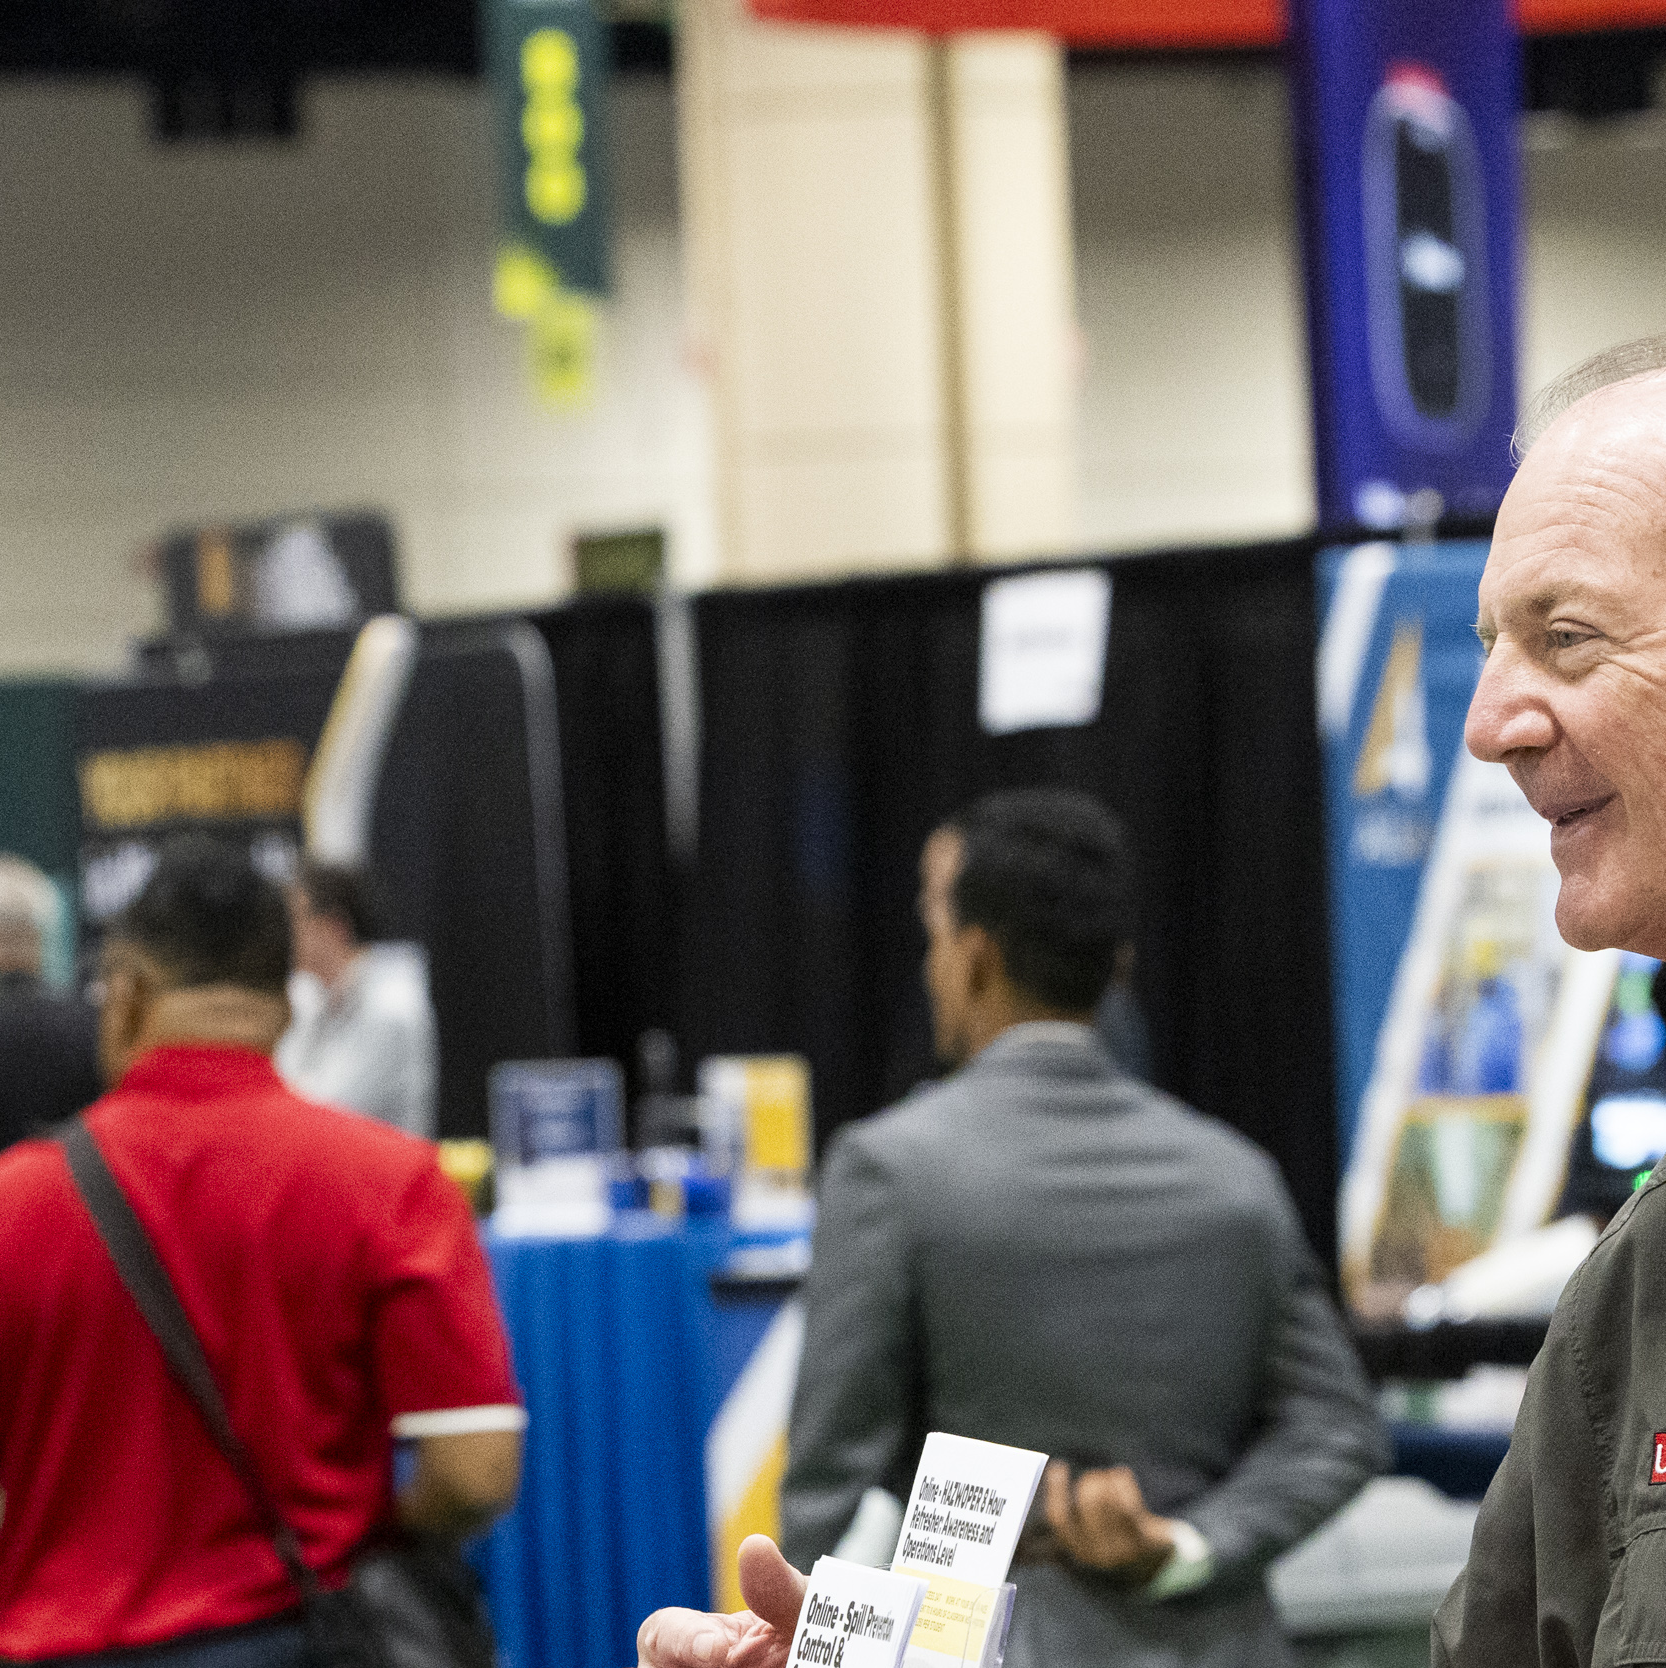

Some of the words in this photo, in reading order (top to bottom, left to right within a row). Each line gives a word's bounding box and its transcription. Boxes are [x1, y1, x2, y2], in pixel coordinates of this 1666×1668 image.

[918, 1475, 940, 1503] Online
[940, 1479, 984, 1513] HAZWOPER
[985, 1489, 1008, 1517] Hour
[941, 1510, 981, 1543] Awareness
[978, 1520, 998, 1546] and
[902, 1532, 939, 1564] Operations
[935, 1540, 958, 1568] Level
[806, 1592, 840, 1630] Online
[843, 1600, 869, 1642] Spill
[797, 1628, 838, 1667] Control
[833, 1636, 845, 1668] &
